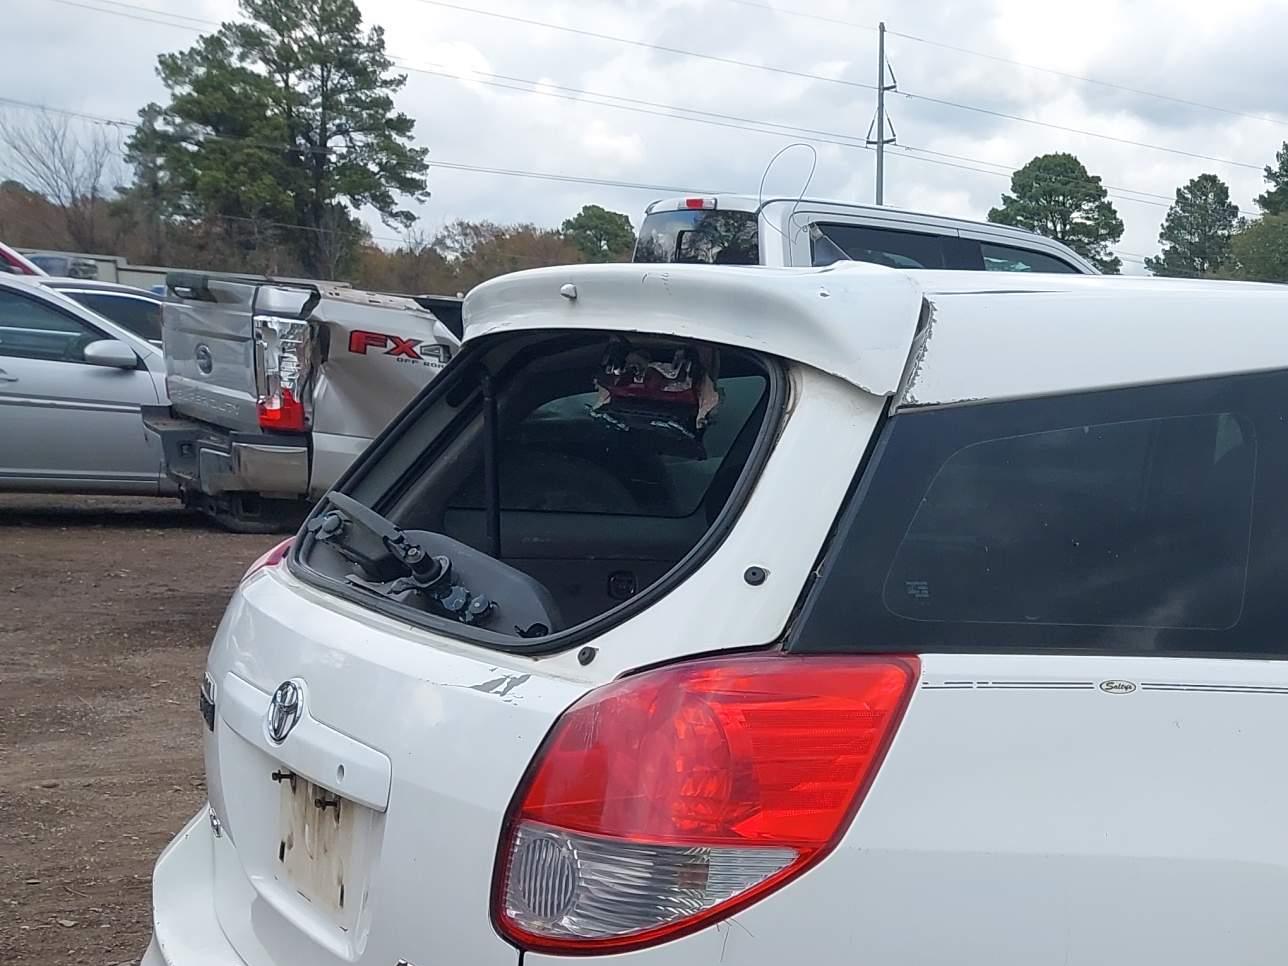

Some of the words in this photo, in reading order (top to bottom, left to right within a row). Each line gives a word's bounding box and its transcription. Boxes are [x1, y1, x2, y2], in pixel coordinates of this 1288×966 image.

[348, 329, 453, 364] FX4
[396, 357, 420, 365] OFF
[423, 361, 447, 369] ROA
